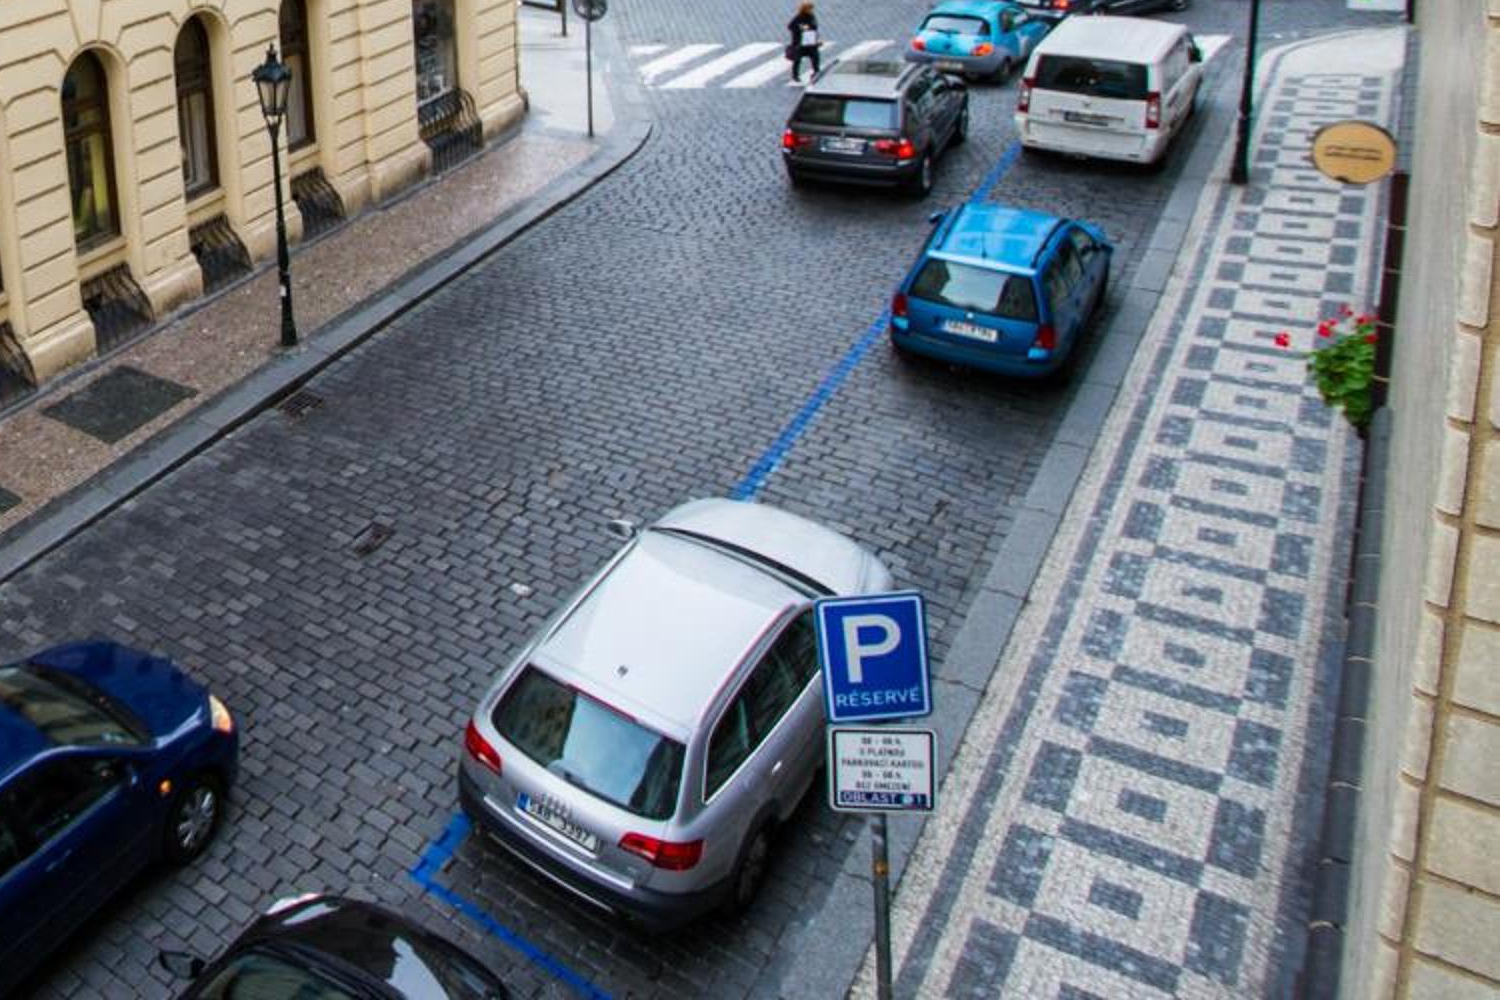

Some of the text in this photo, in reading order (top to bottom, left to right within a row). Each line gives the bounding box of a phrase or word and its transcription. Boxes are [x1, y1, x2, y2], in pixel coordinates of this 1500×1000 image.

[842, 613, 901, 684] P
[835, 684, 920, 708] RÉSERVÉ
[844, 792, 896, 804] OBLAST
